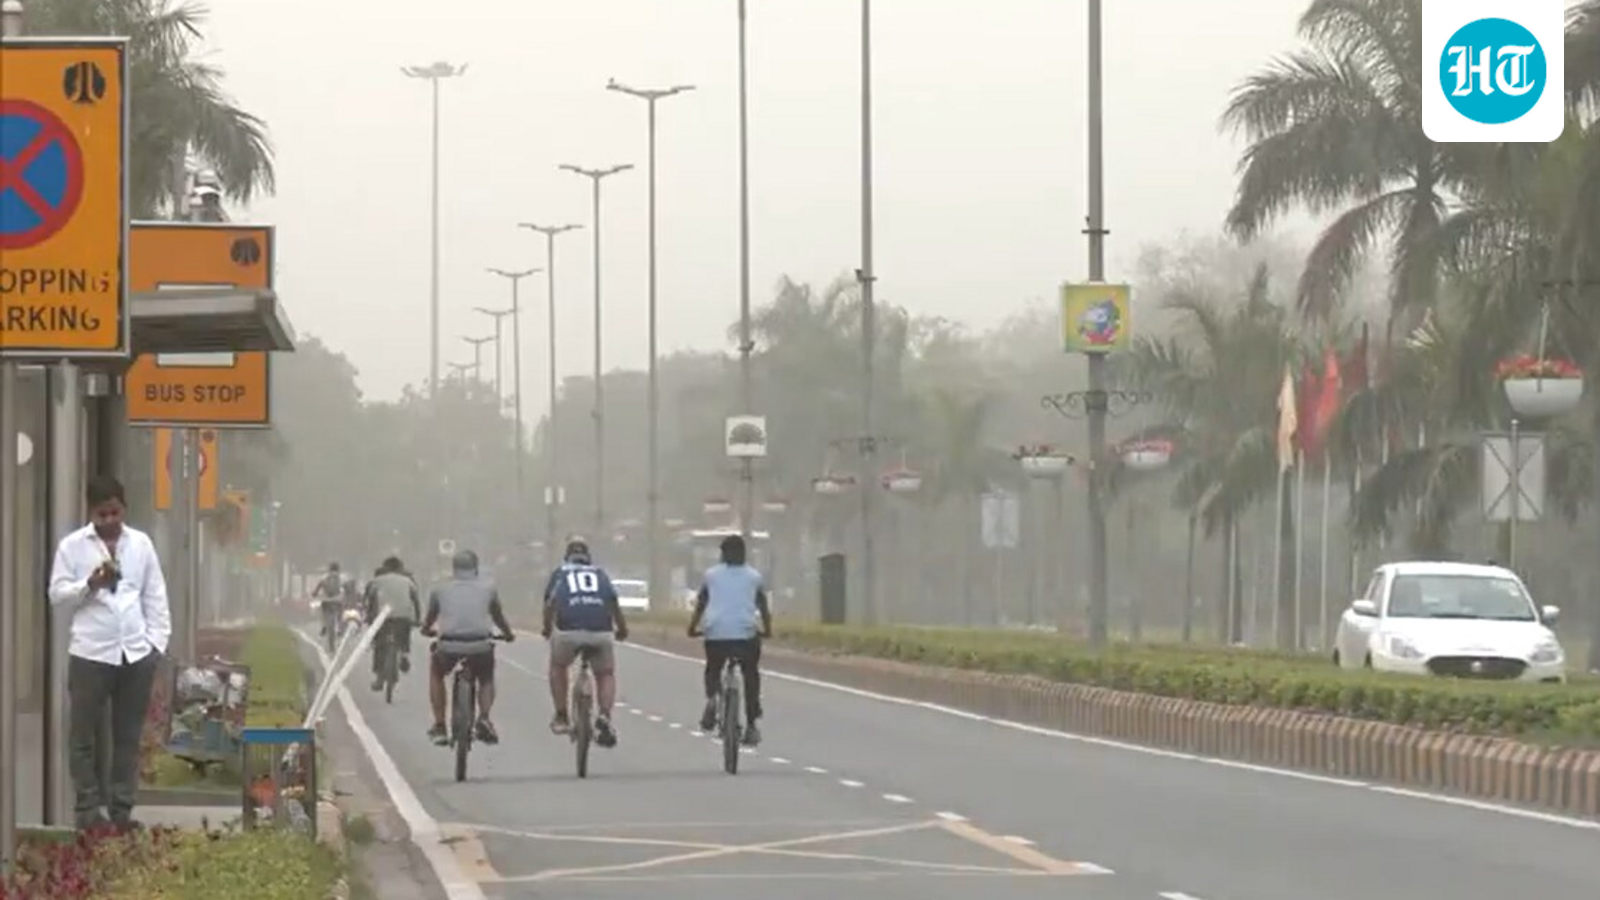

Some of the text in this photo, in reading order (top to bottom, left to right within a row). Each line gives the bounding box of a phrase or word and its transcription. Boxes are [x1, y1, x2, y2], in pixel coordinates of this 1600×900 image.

[0, 306, 100, 331] RKING
[145, 384, 246, 402] BUS STOP
[567, 571, 598, 593] 10
